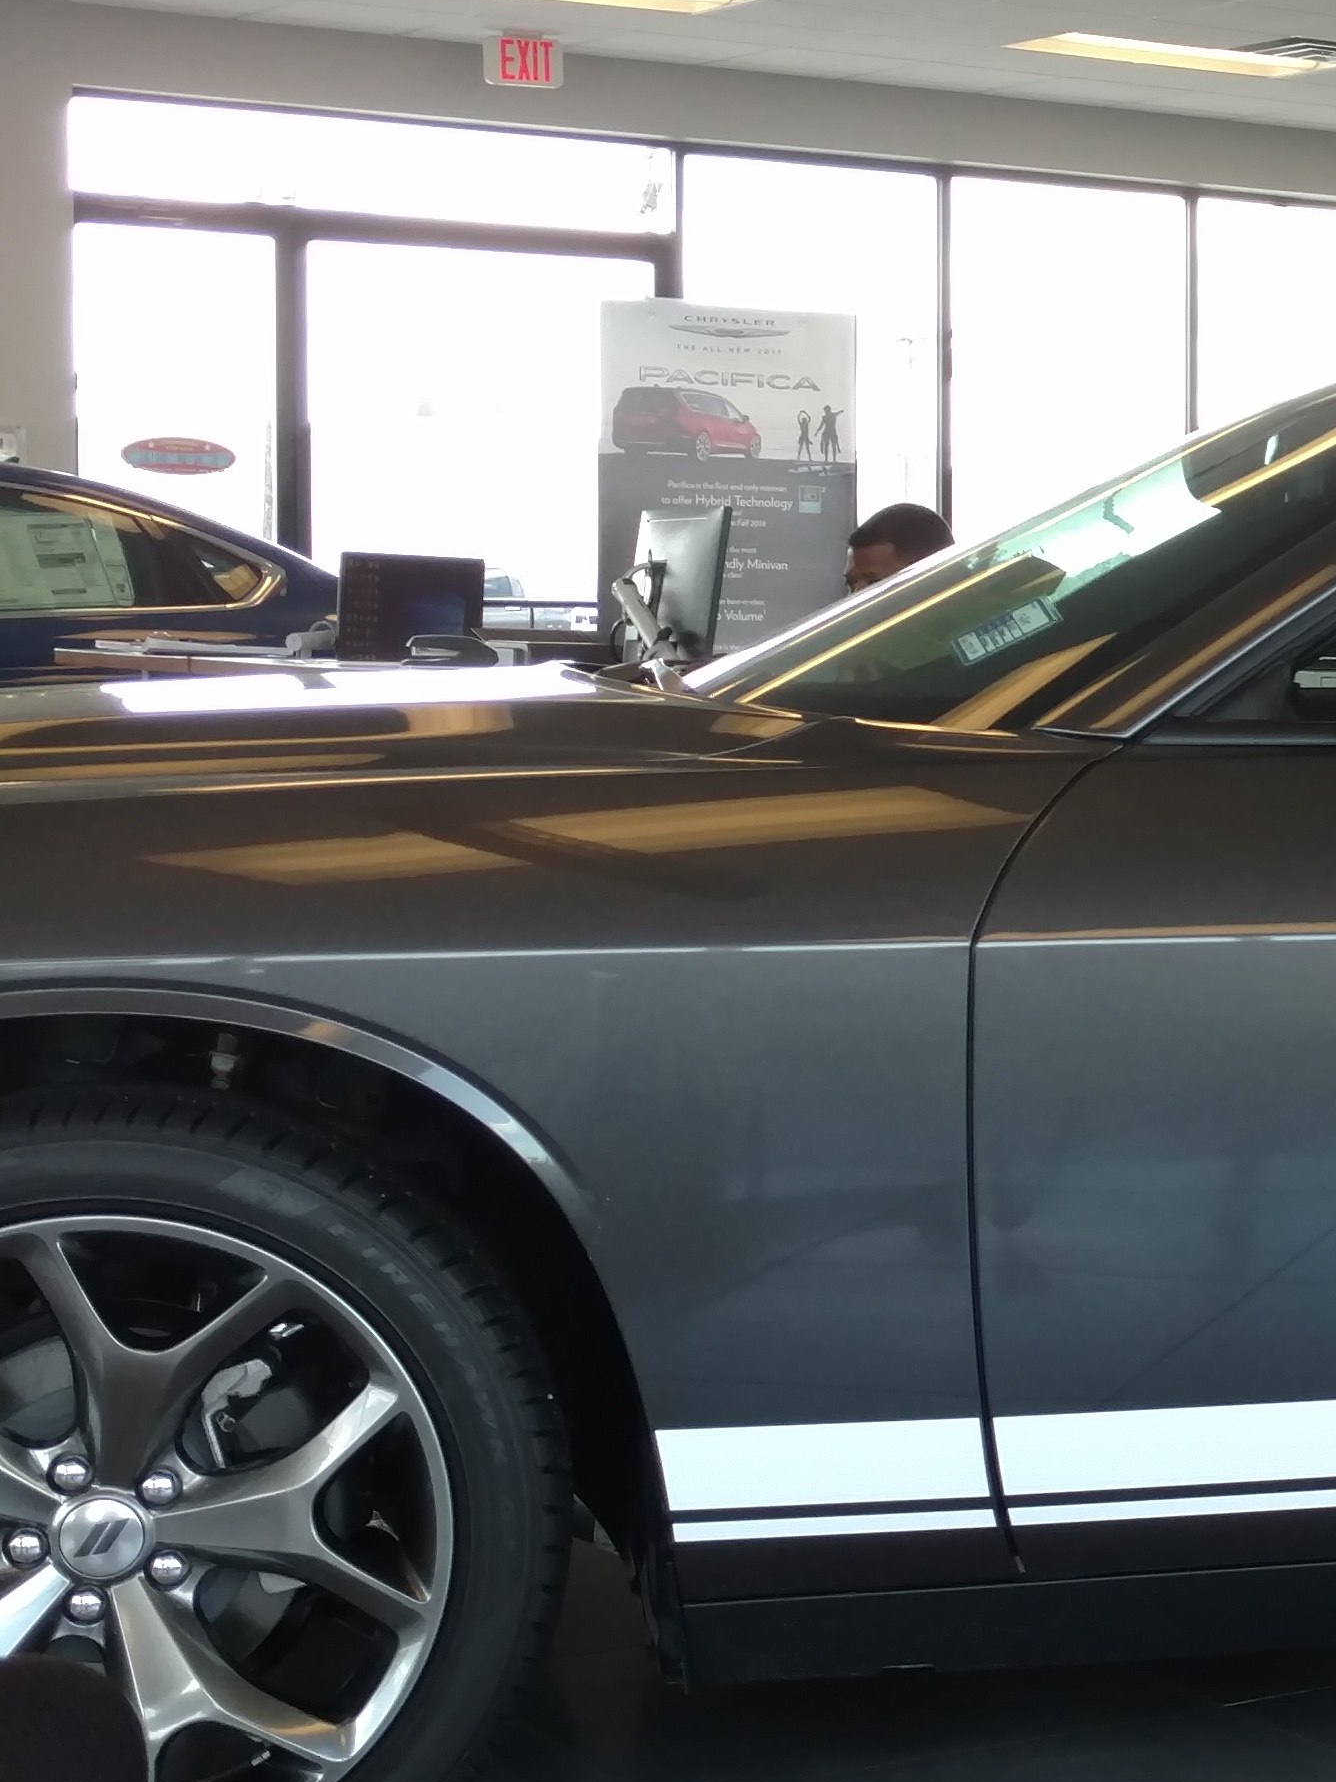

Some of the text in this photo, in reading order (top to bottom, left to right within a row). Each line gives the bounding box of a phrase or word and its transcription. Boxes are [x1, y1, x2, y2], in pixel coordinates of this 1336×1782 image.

[500, 39, 553, 82] EXIT
[684, 315, 776, 326] CHRYSLER
[677, 344, 697, 352] THE
[703, 345, 722, 353] ALL
[729, 347, 751, 355] NEW
[639, 366, 821, 392] PACIFICA
[730, 483, 744, 491] and
[662, 497, 671, 505] to
[672, 495, 693, 505] offer
[695, 495, 732, 507] Hybrid
[734, 495, 793, 511] Technology
[747, 559, 788, 571] Minivan
